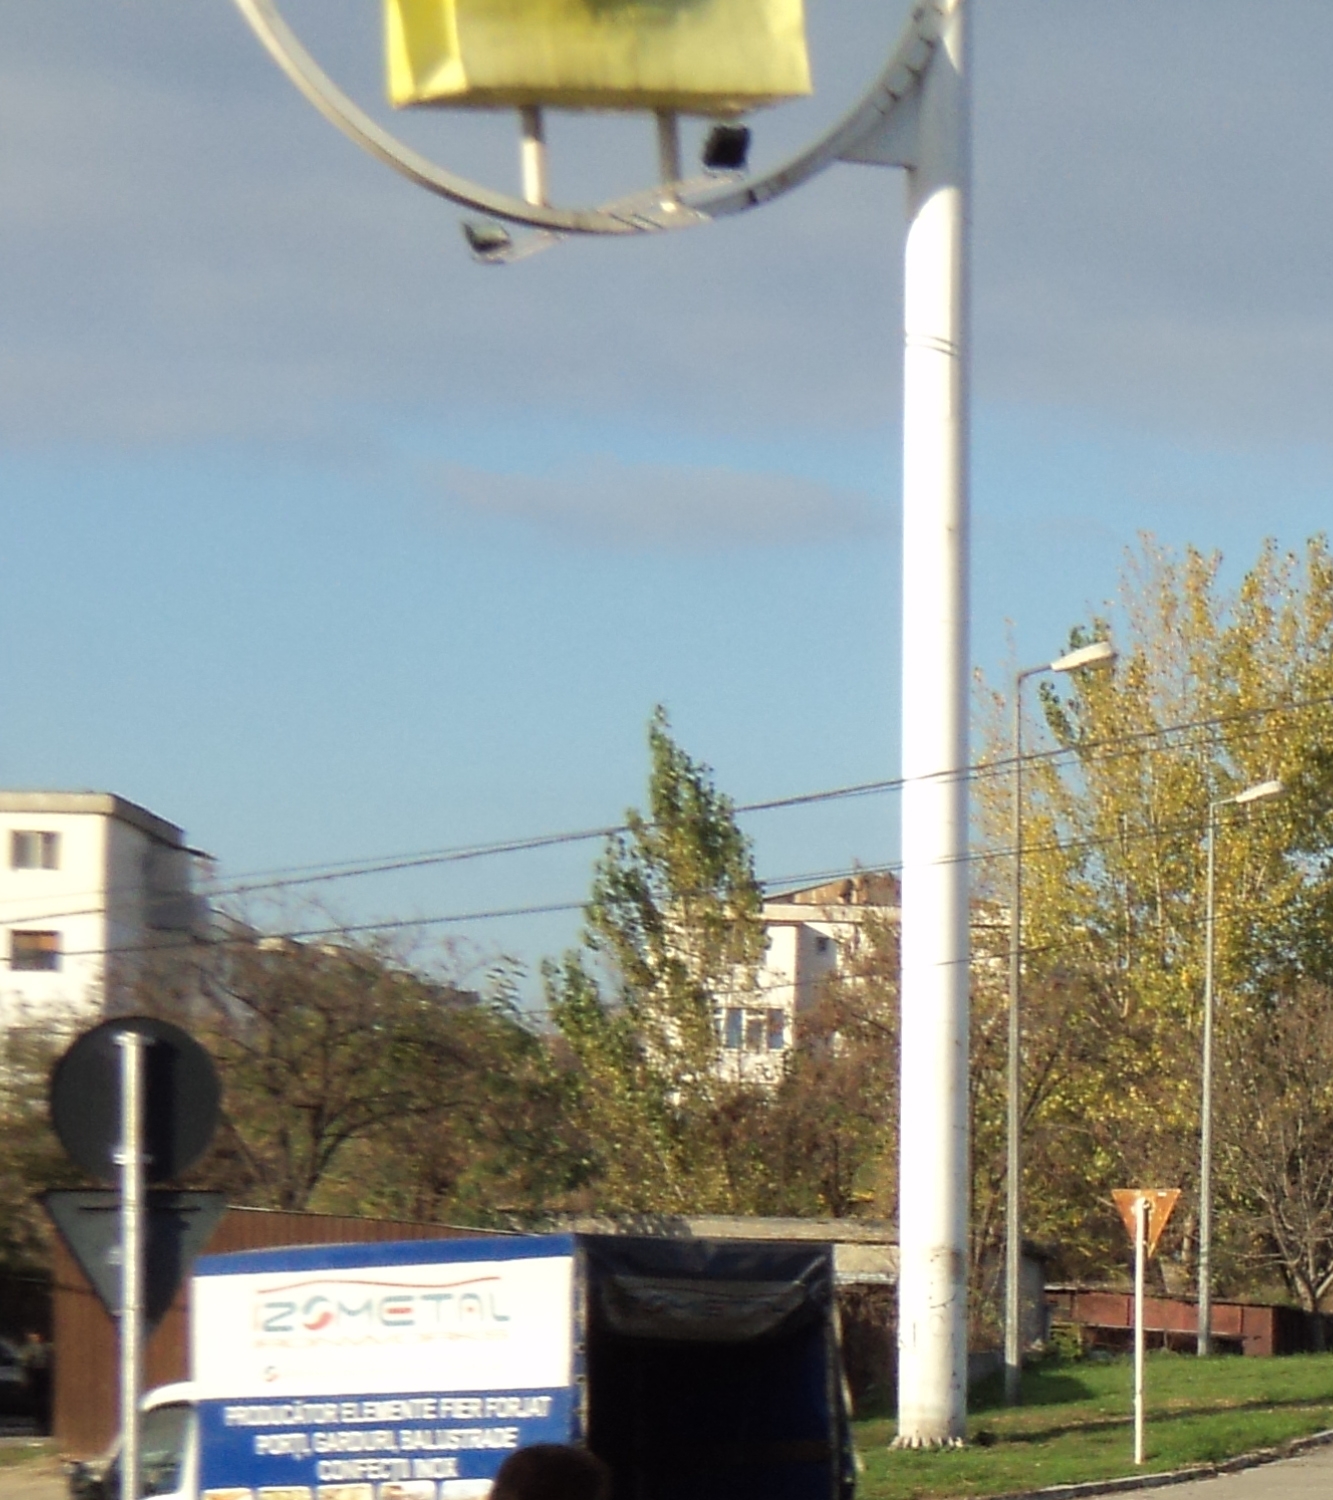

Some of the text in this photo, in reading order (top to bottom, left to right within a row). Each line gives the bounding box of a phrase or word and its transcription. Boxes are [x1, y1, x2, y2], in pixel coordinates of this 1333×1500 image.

[339, 1397, 438, 1423] ELEMENTE
[440, 1397, 482, 1419] FIER
[485, 1396, 552, 1418] FORJAT
[400, 1426, 519, 1450] BALUSTRADE
